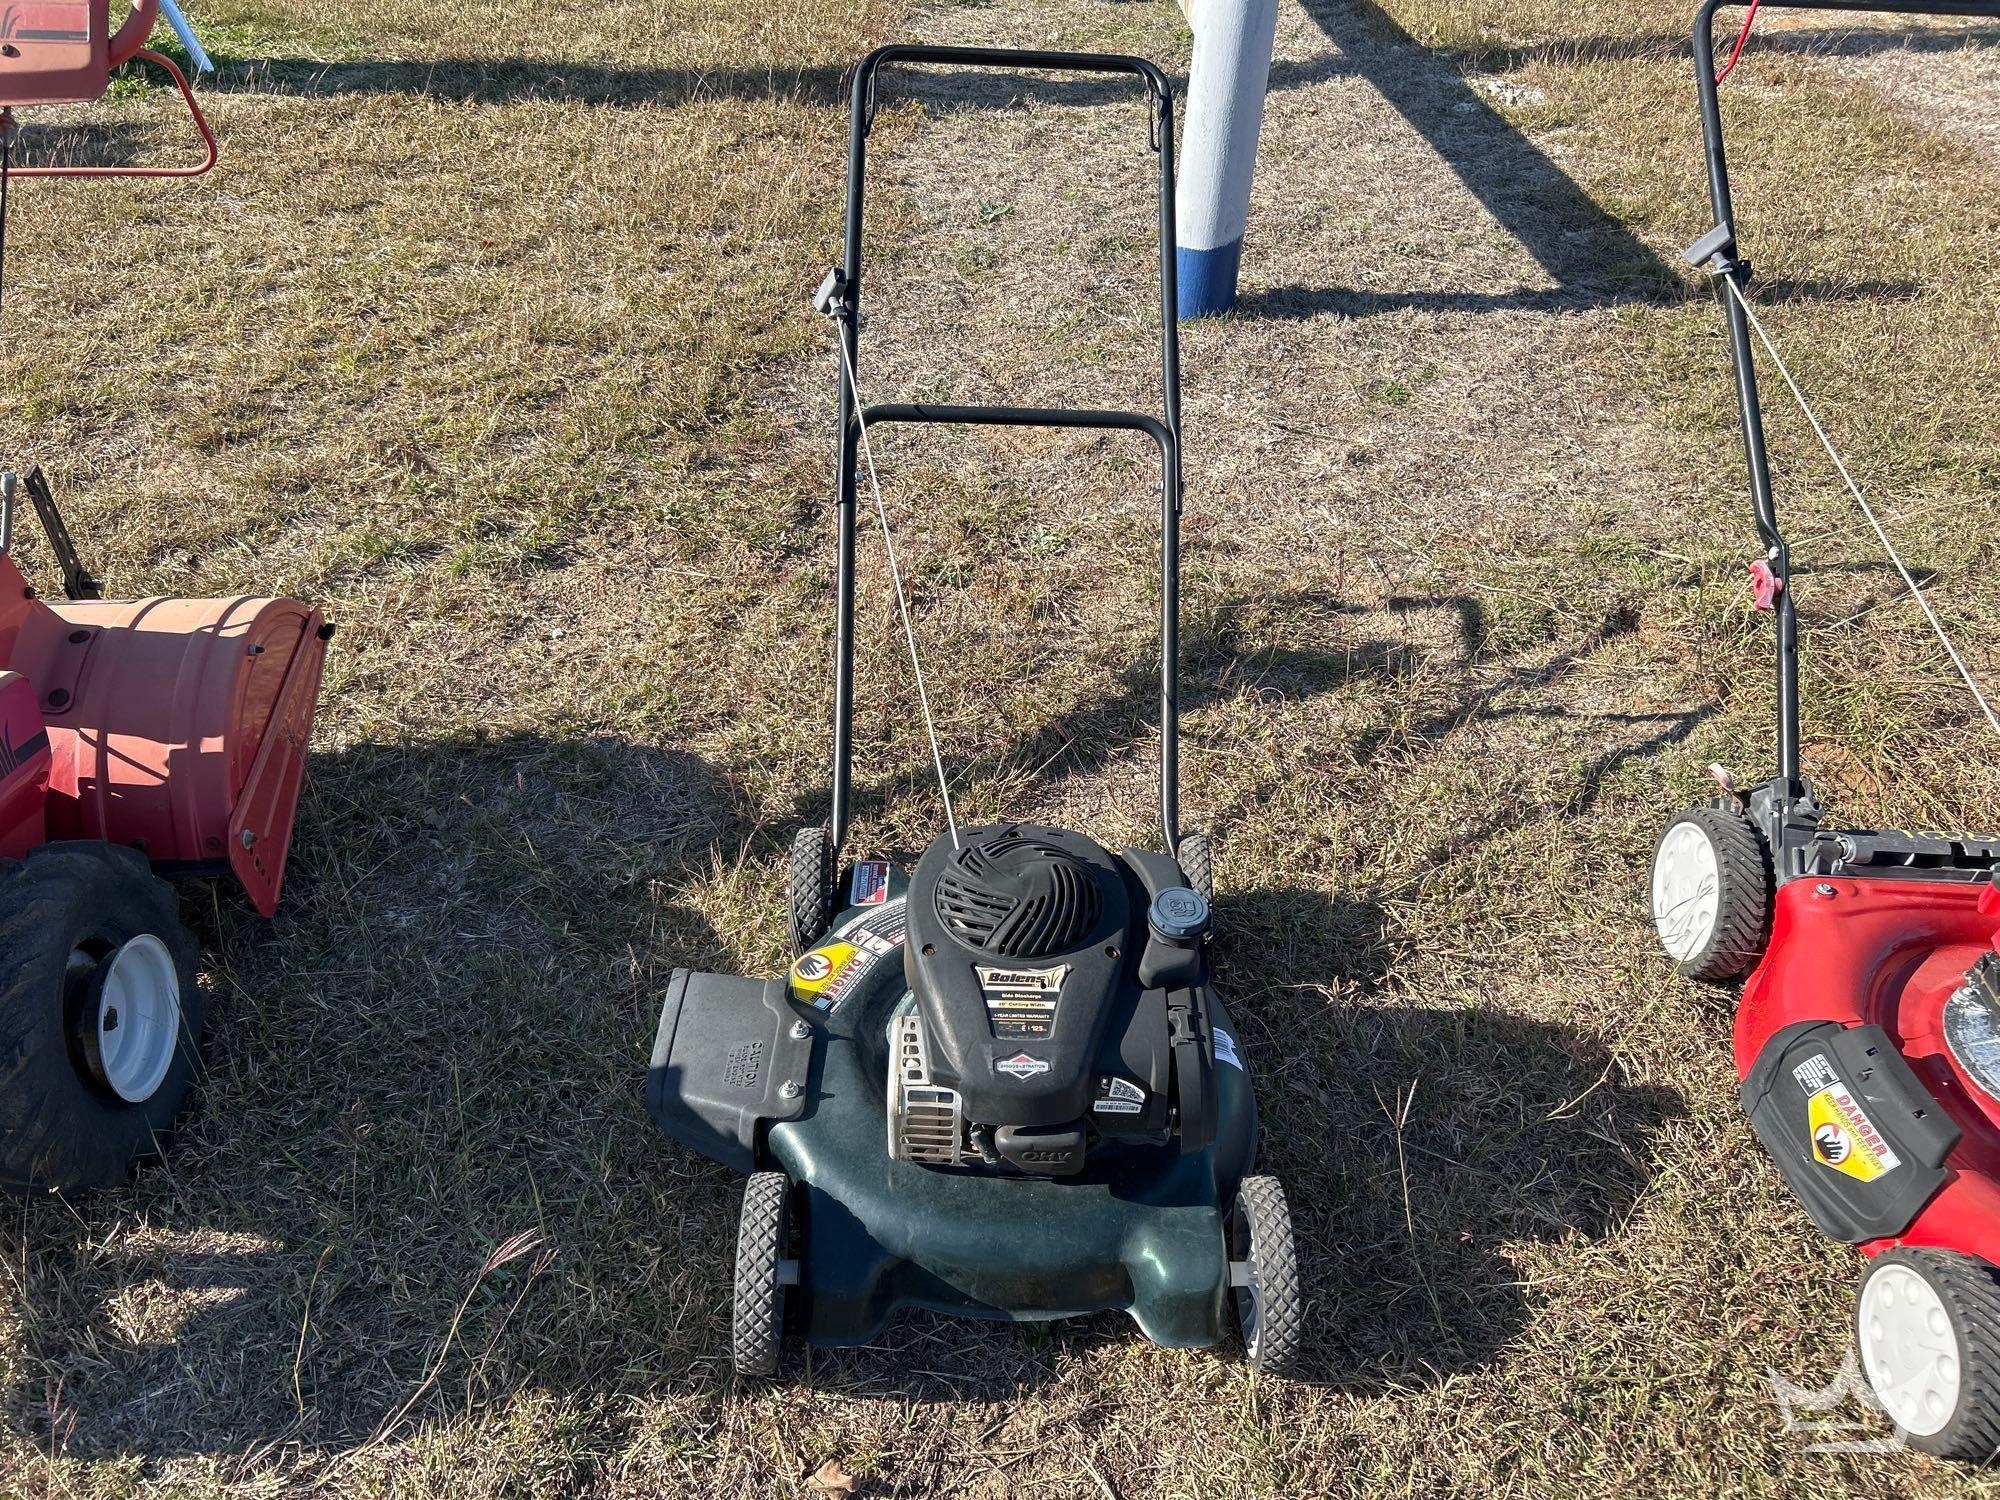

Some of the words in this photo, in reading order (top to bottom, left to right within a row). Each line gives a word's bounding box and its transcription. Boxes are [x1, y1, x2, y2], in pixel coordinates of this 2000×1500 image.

[822, 959, 863, 1001] DANGER
[988, 973, 1046, 984] Bolens
[744, 1043, 763, 1088] CAUTION
[1824, 1093, 1837, 1108] KEEP
[1834, 1106, 1851, 1128] HANDS
[1856, 1137, 1869, 1153] FEET
[1866, 1151, 1883, 1170] AWAY
[1836, 1094, 1888, 1157] DANGER
[1021, 1151, 1073, 1161] OHV
